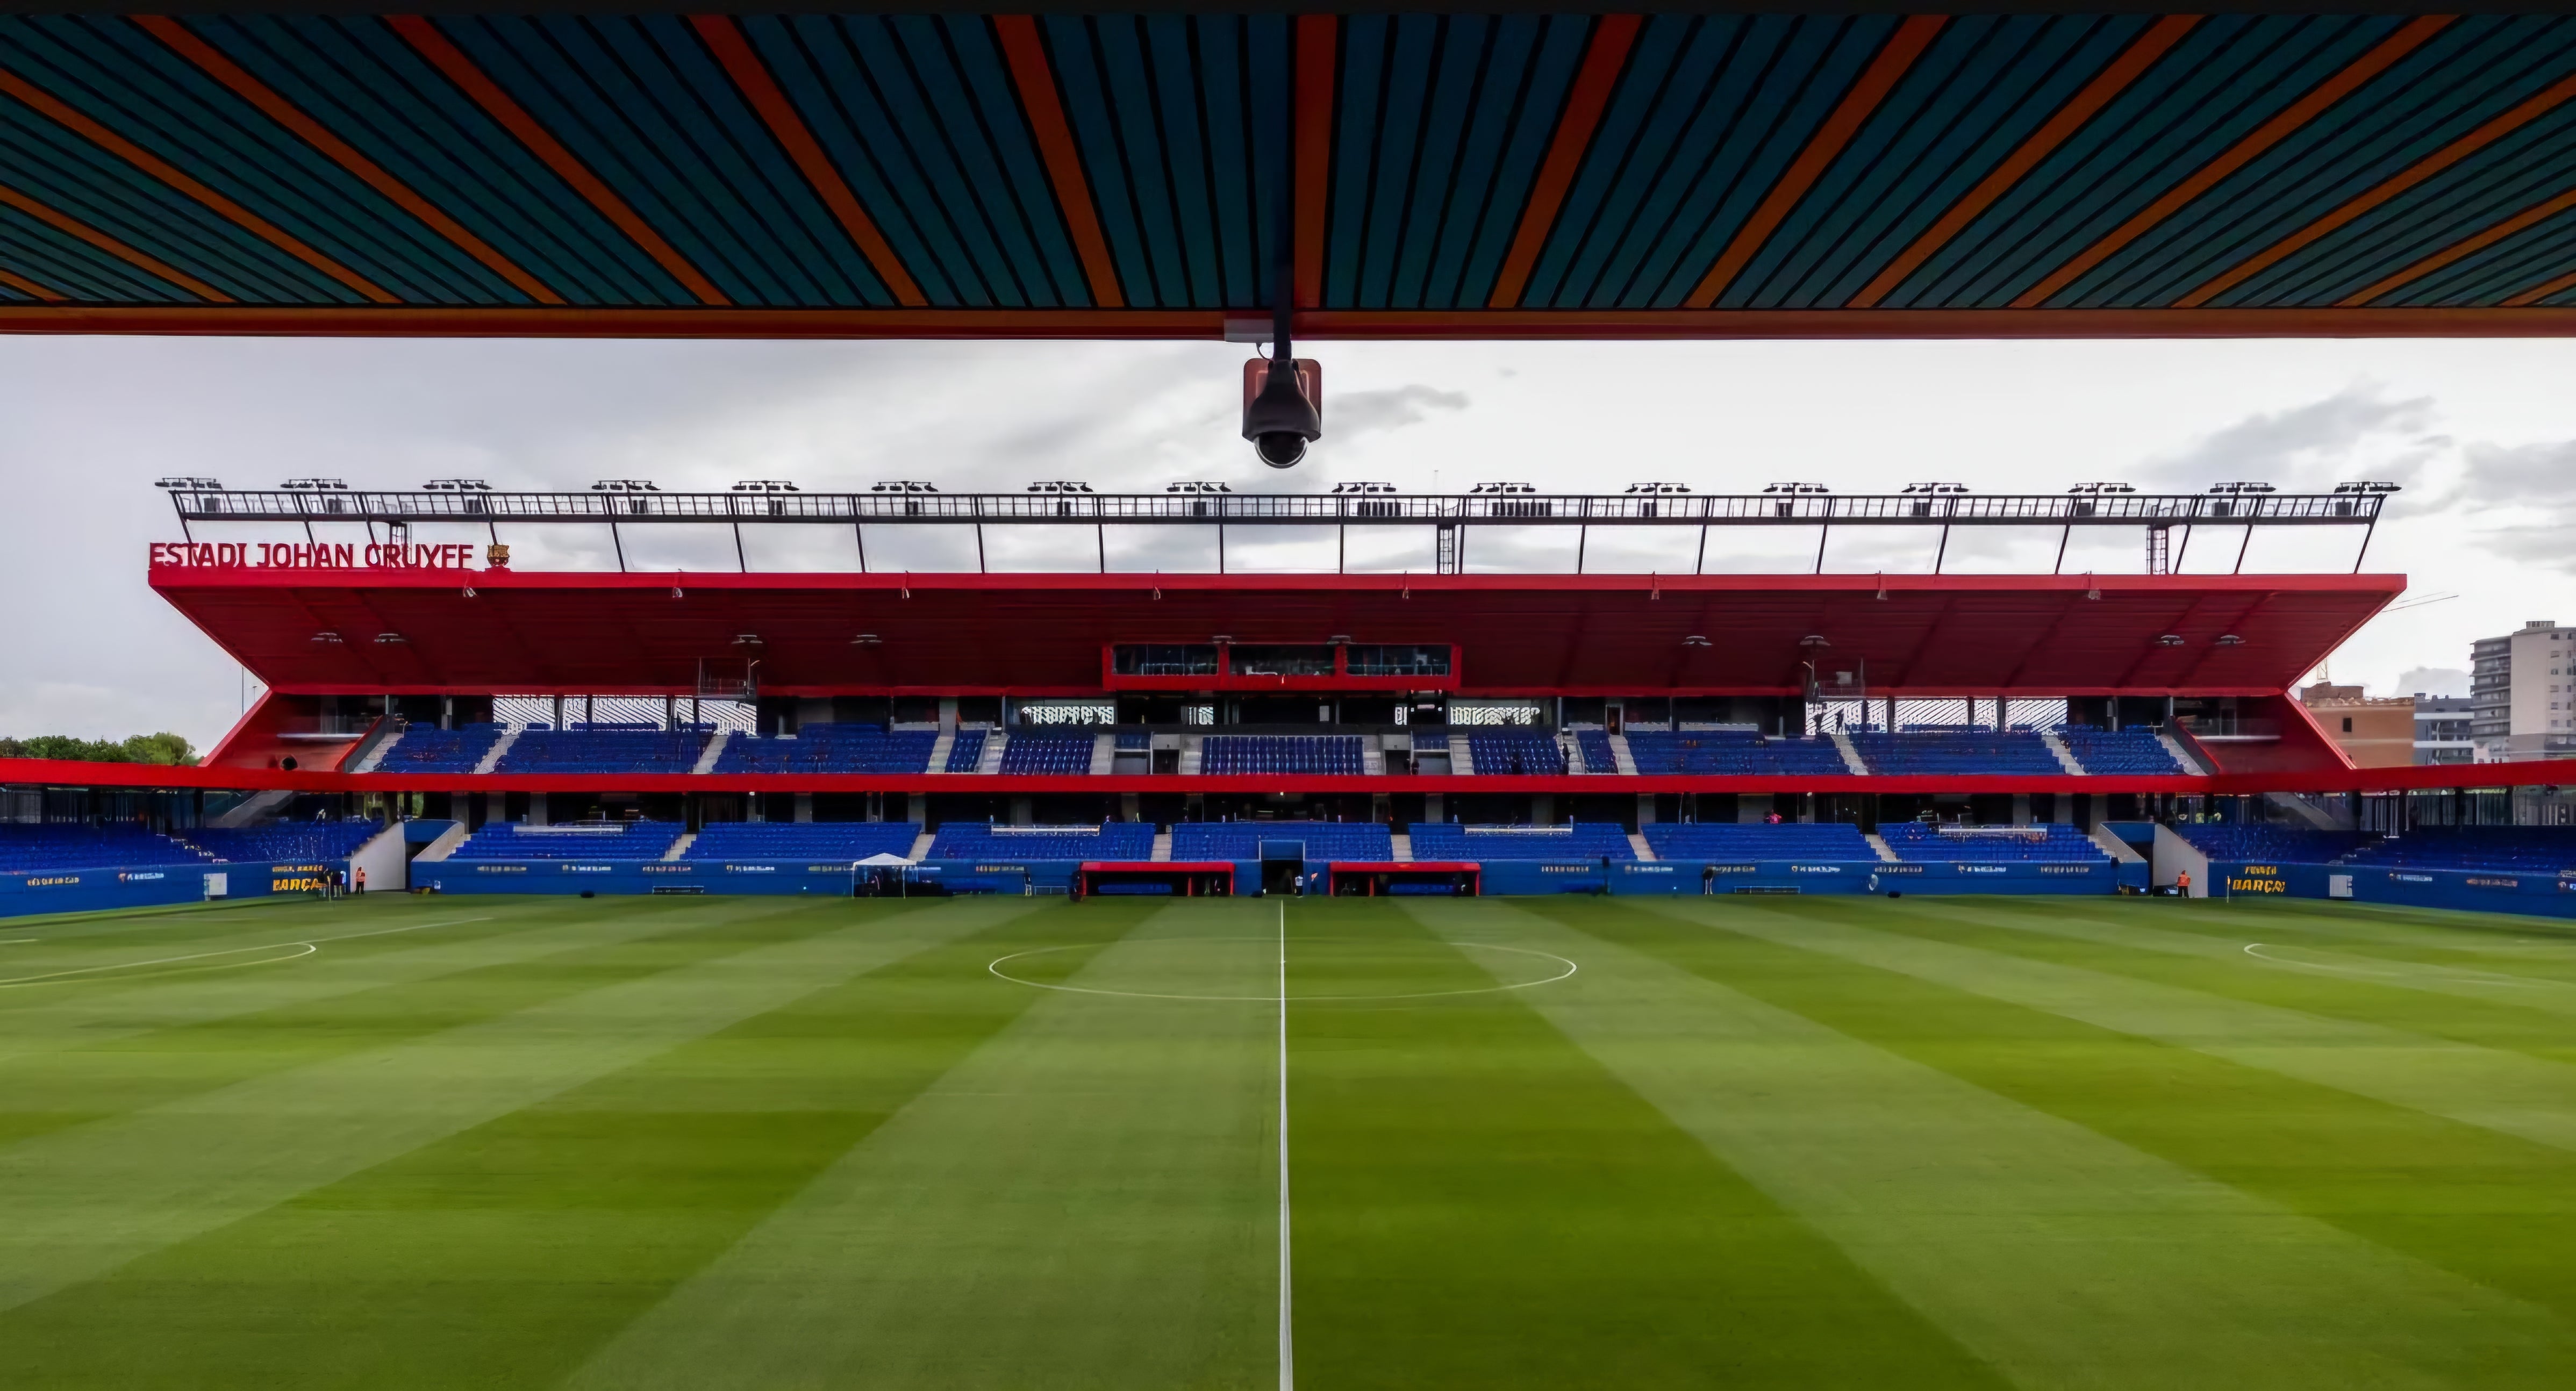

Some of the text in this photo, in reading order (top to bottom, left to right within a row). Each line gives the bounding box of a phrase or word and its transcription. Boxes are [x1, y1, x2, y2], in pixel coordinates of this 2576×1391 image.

[150, 543, 474, 568] ESTADI JOHAN CRUYFF
